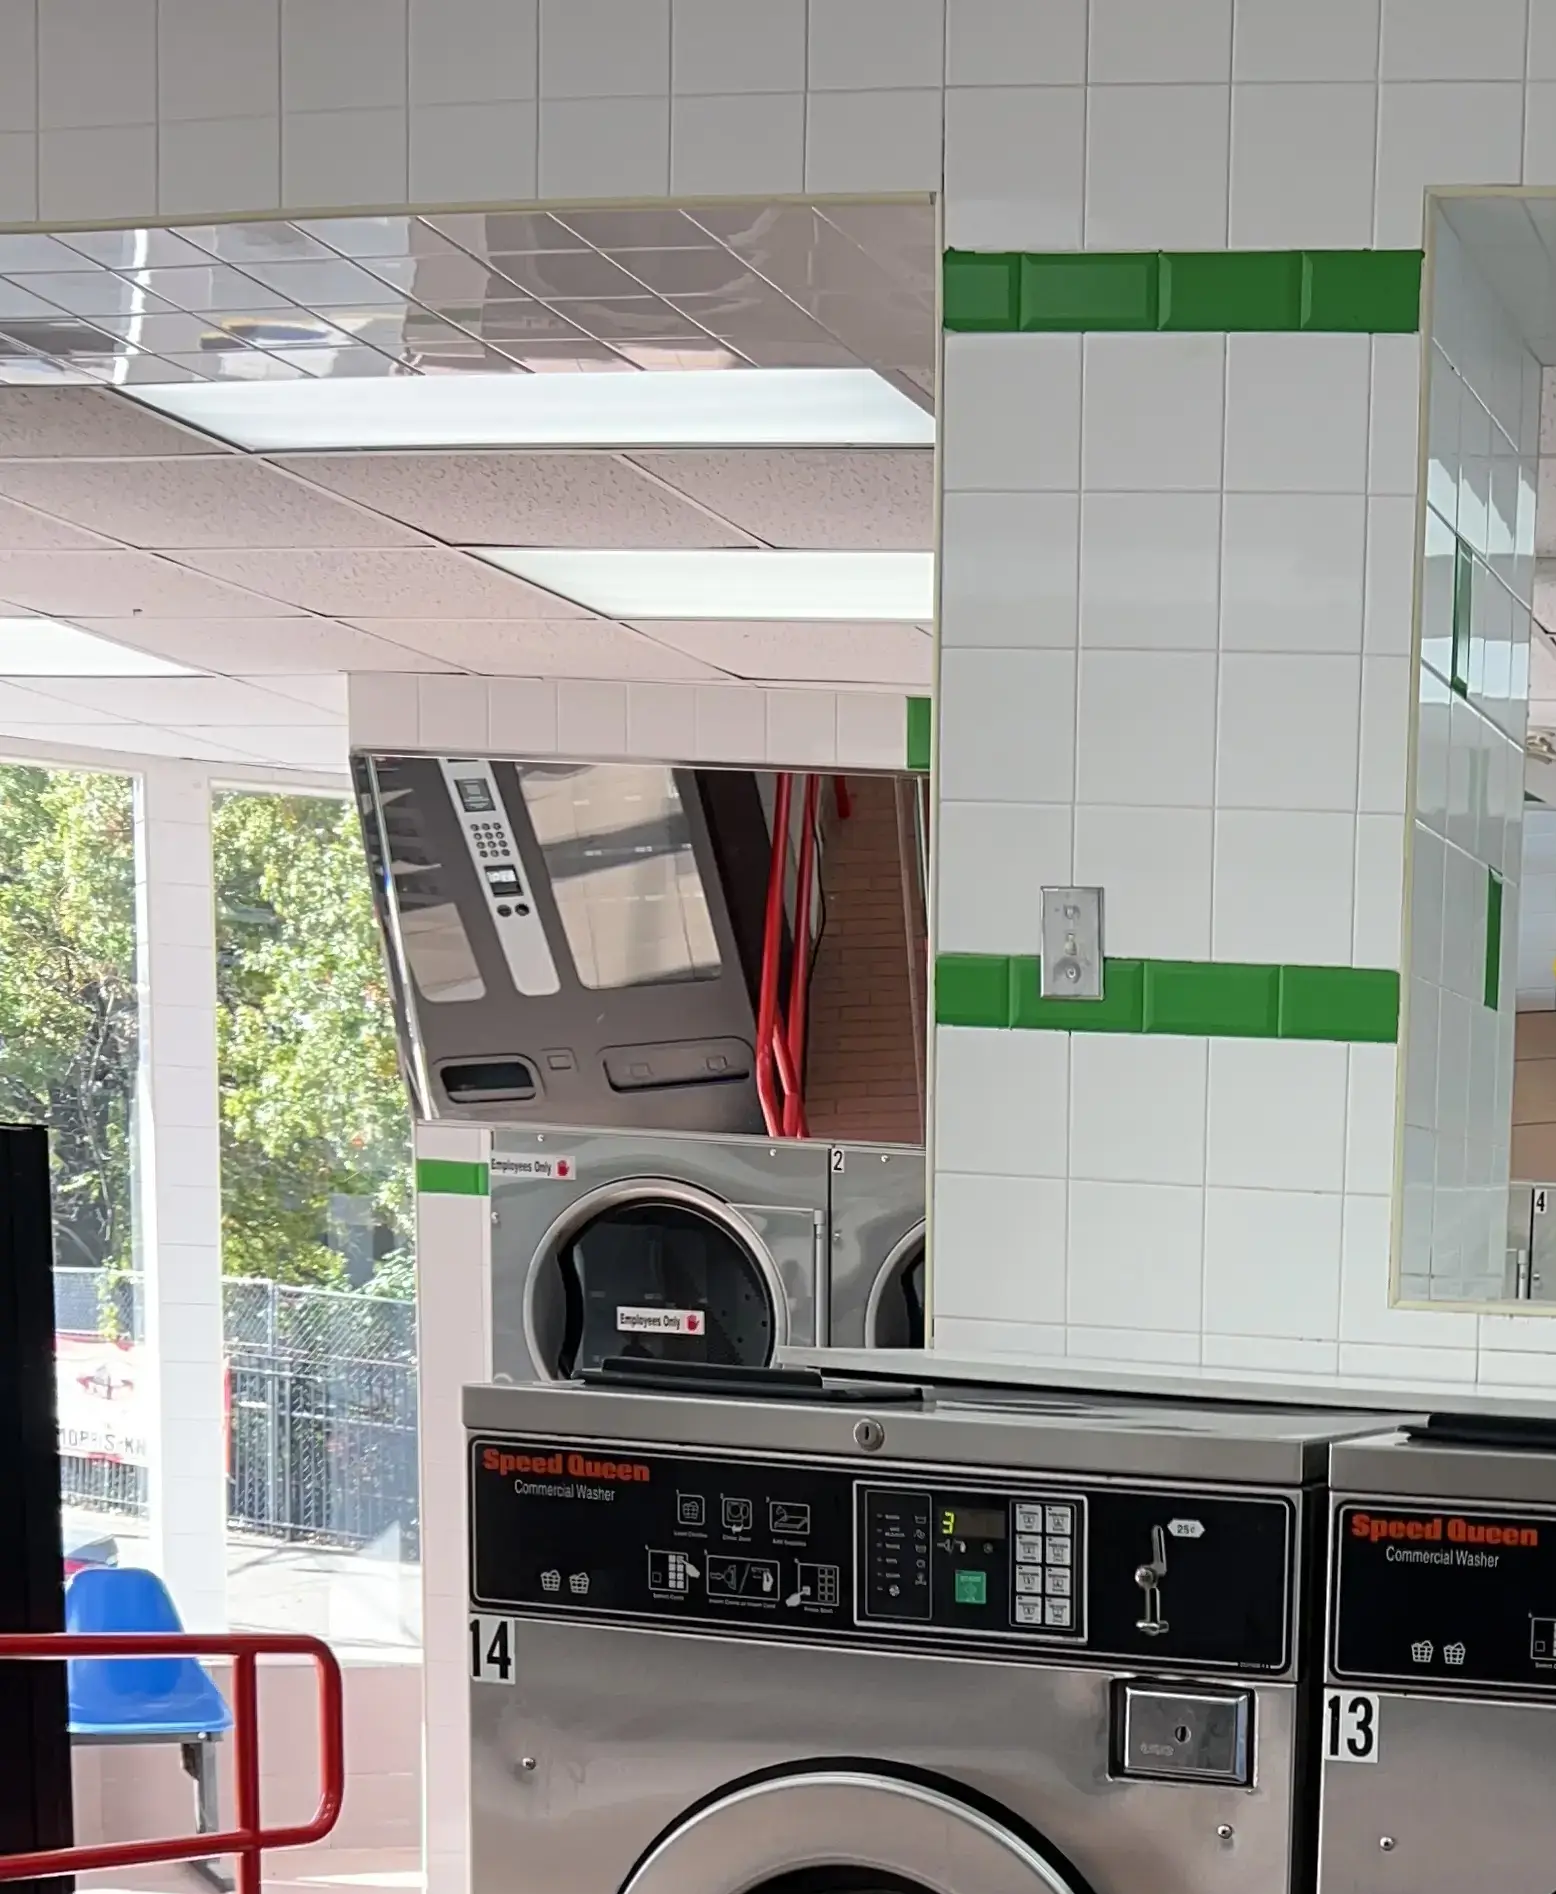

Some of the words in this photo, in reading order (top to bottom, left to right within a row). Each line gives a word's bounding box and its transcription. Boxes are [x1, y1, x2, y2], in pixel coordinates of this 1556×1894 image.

[491, 1158, 532, 1173] Employees
[534, 1160, 552, 1175] Only
[833, 1151, 843, 1171] 2
[1536, 1191, 1545, 1212] 4
[620, 1313, 661, 1329] Employees
[663, 1316, 681, 1331] Only
[484, 1449, 562, 1475] Speed
[568, 1456, 649, 1481] Queen
[515, 1480, 574, 1499] Commercial
[576, 1484, 615, 1501] Washer
[942, 1512, 955, 1535] 3
[1352, 1514, 1441, 1542] Speed
[1447, 1518, 1538, 1546] Queen
[1386, 1546, 1454, 1566] Commercial
[1455, 1551, 1499, 1569] Washer
[469, 1619, 511, 1679] 14
[1329, 1696, 1373, 1757] 13
